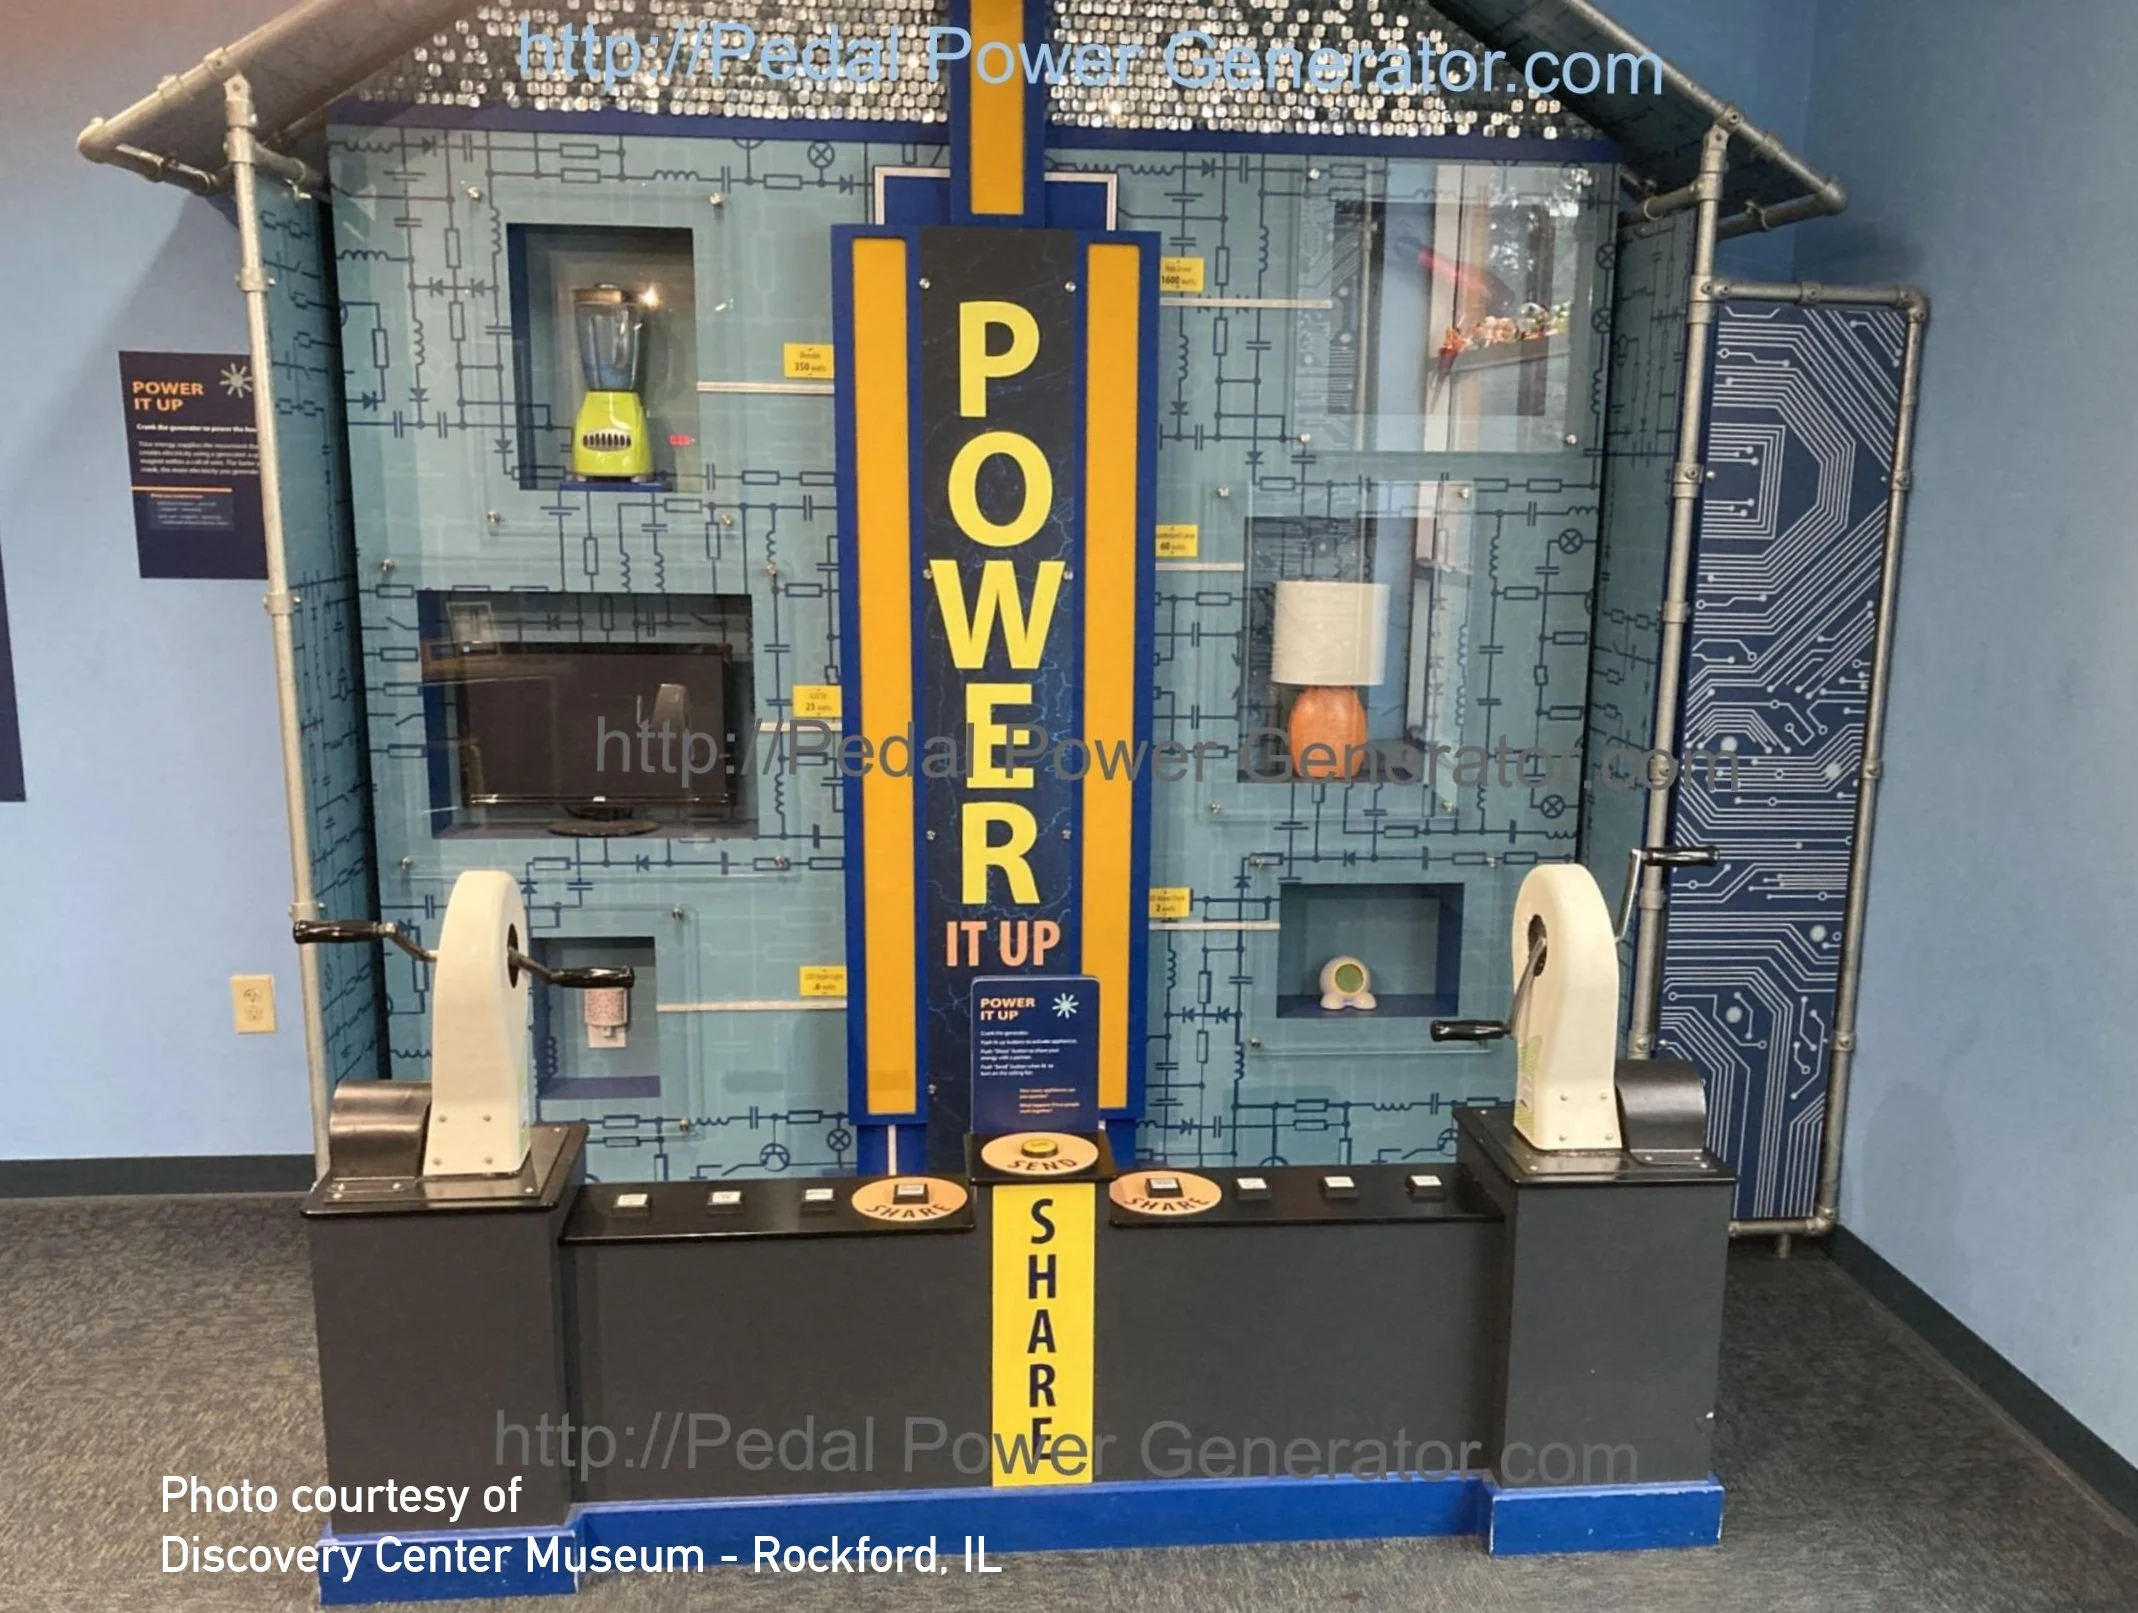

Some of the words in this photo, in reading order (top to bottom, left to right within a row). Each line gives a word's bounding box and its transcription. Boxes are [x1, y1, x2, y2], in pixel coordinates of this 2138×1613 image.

[132, 381, 204, 396] POWER
[134, 398, 152, 410] IT
[156, 398, 184, 412] UP
[930, 301, 1065, 905] POWER
[945, 921, 987, 966] IT
[1000, 920, 1060, 967] UP
[980, 997, 1036, 1008] POWER
[980, 1010, 996, 1021] IT
[997, 1010, 1019, 1021] UP
[1007, 1158, 1078, 1172] SEND
[864, 1203, 952, 1220] SHARE
[1126, 1197, 1210, 1212] SHARE
